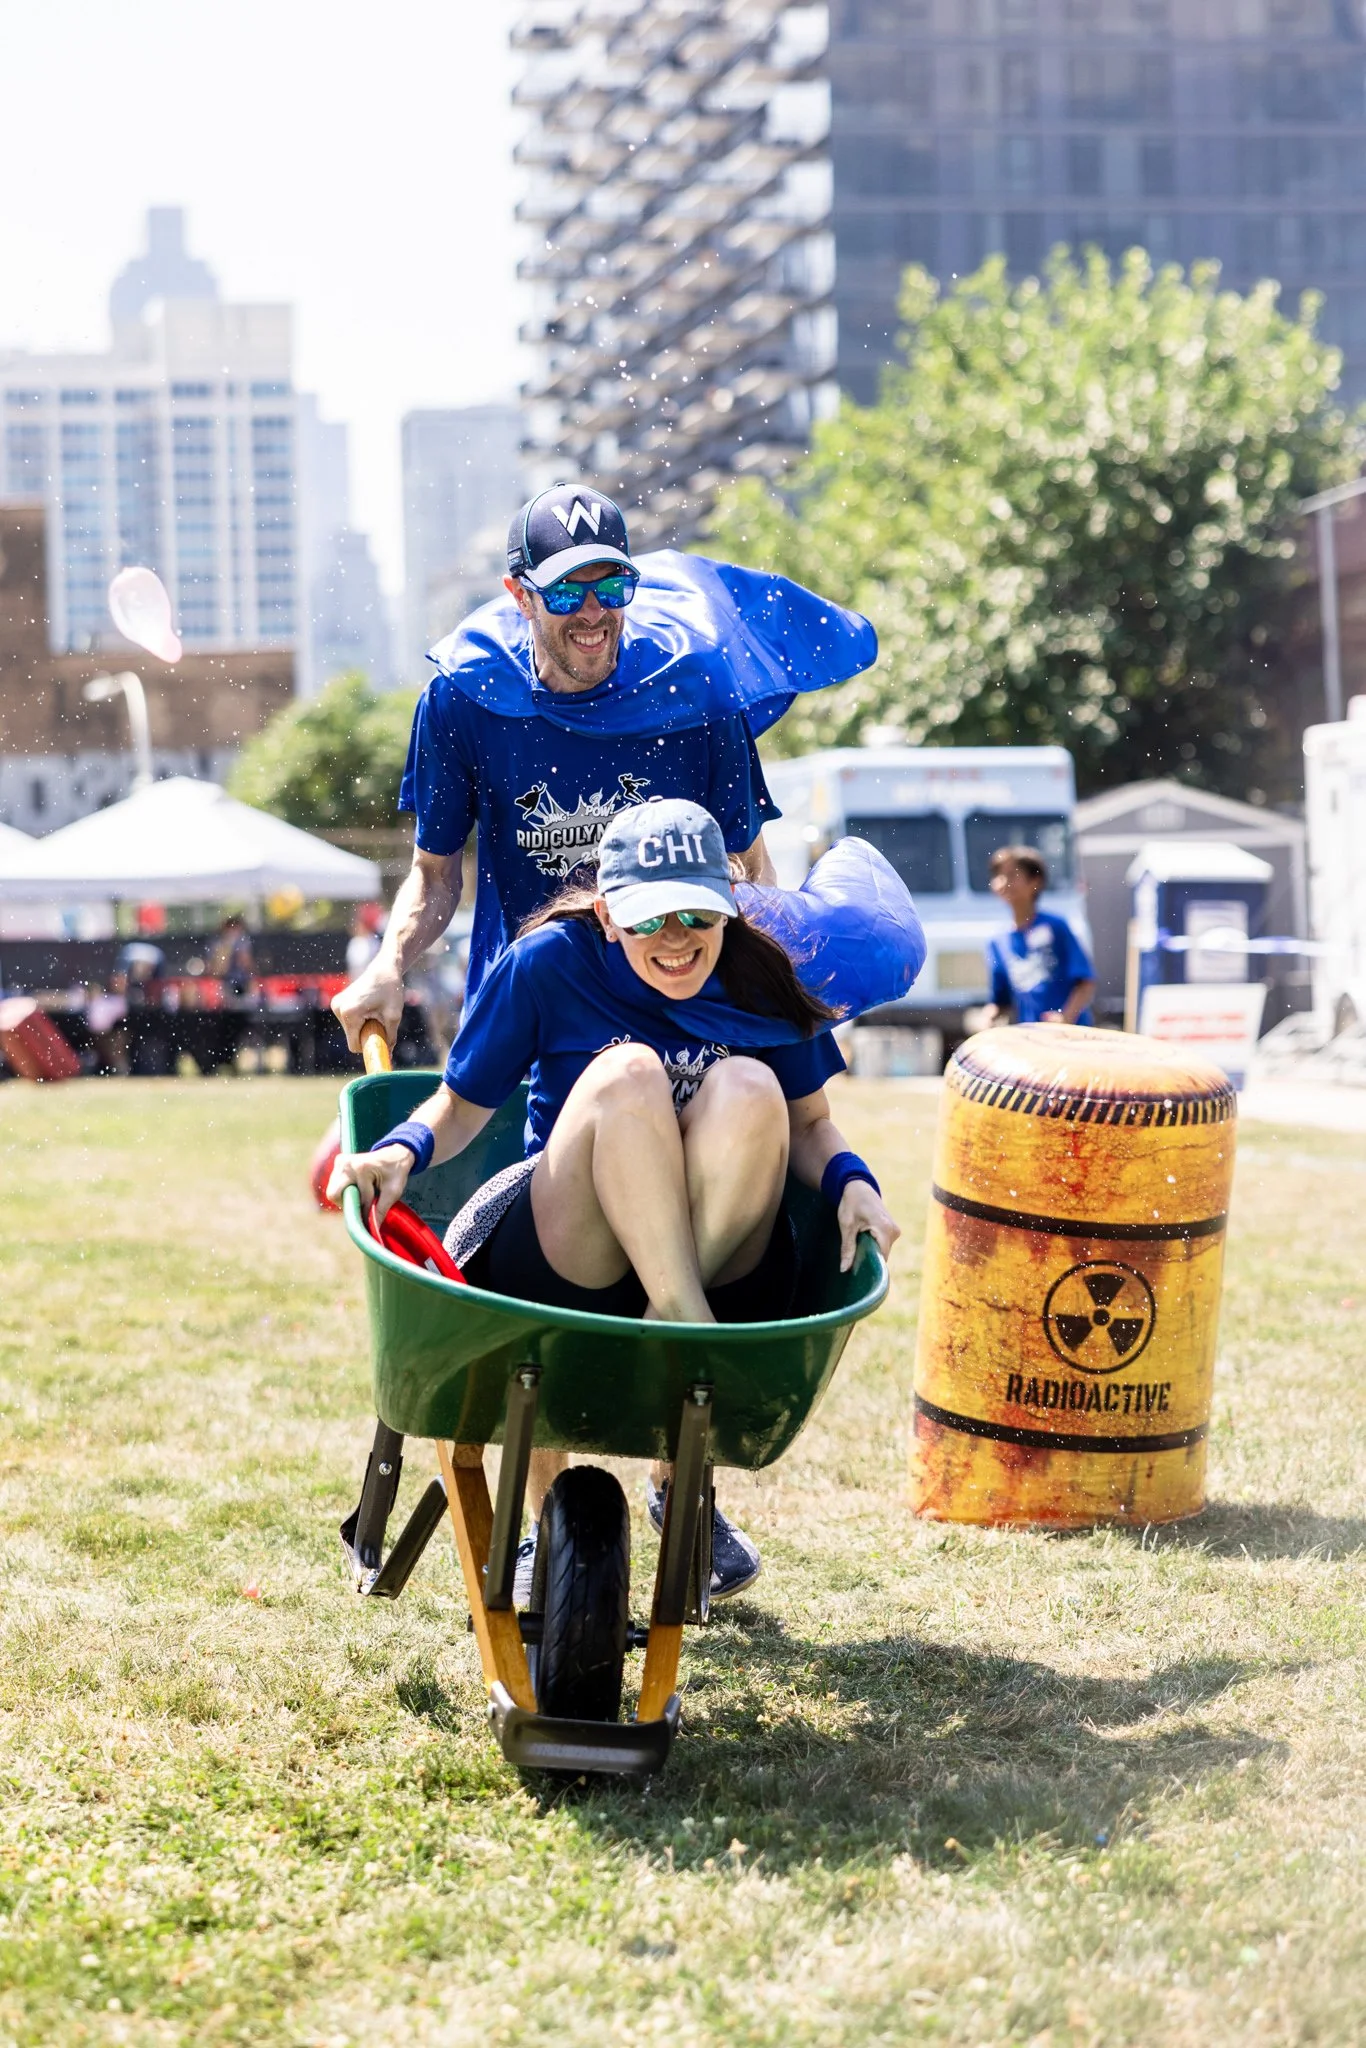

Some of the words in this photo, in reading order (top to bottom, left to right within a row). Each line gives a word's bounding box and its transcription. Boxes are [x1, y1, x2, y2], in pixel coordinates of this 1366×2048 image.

[551, 500, 601, 537] W
[543, 811, 571, 825] BANG!
[585, 803, 616, 817] POW!
[638, 834, 708, 868] CHI
[671, 1061, 705, 1076] POW!
[1006, 1373, 1171, 1414] RADIOACTIVE
